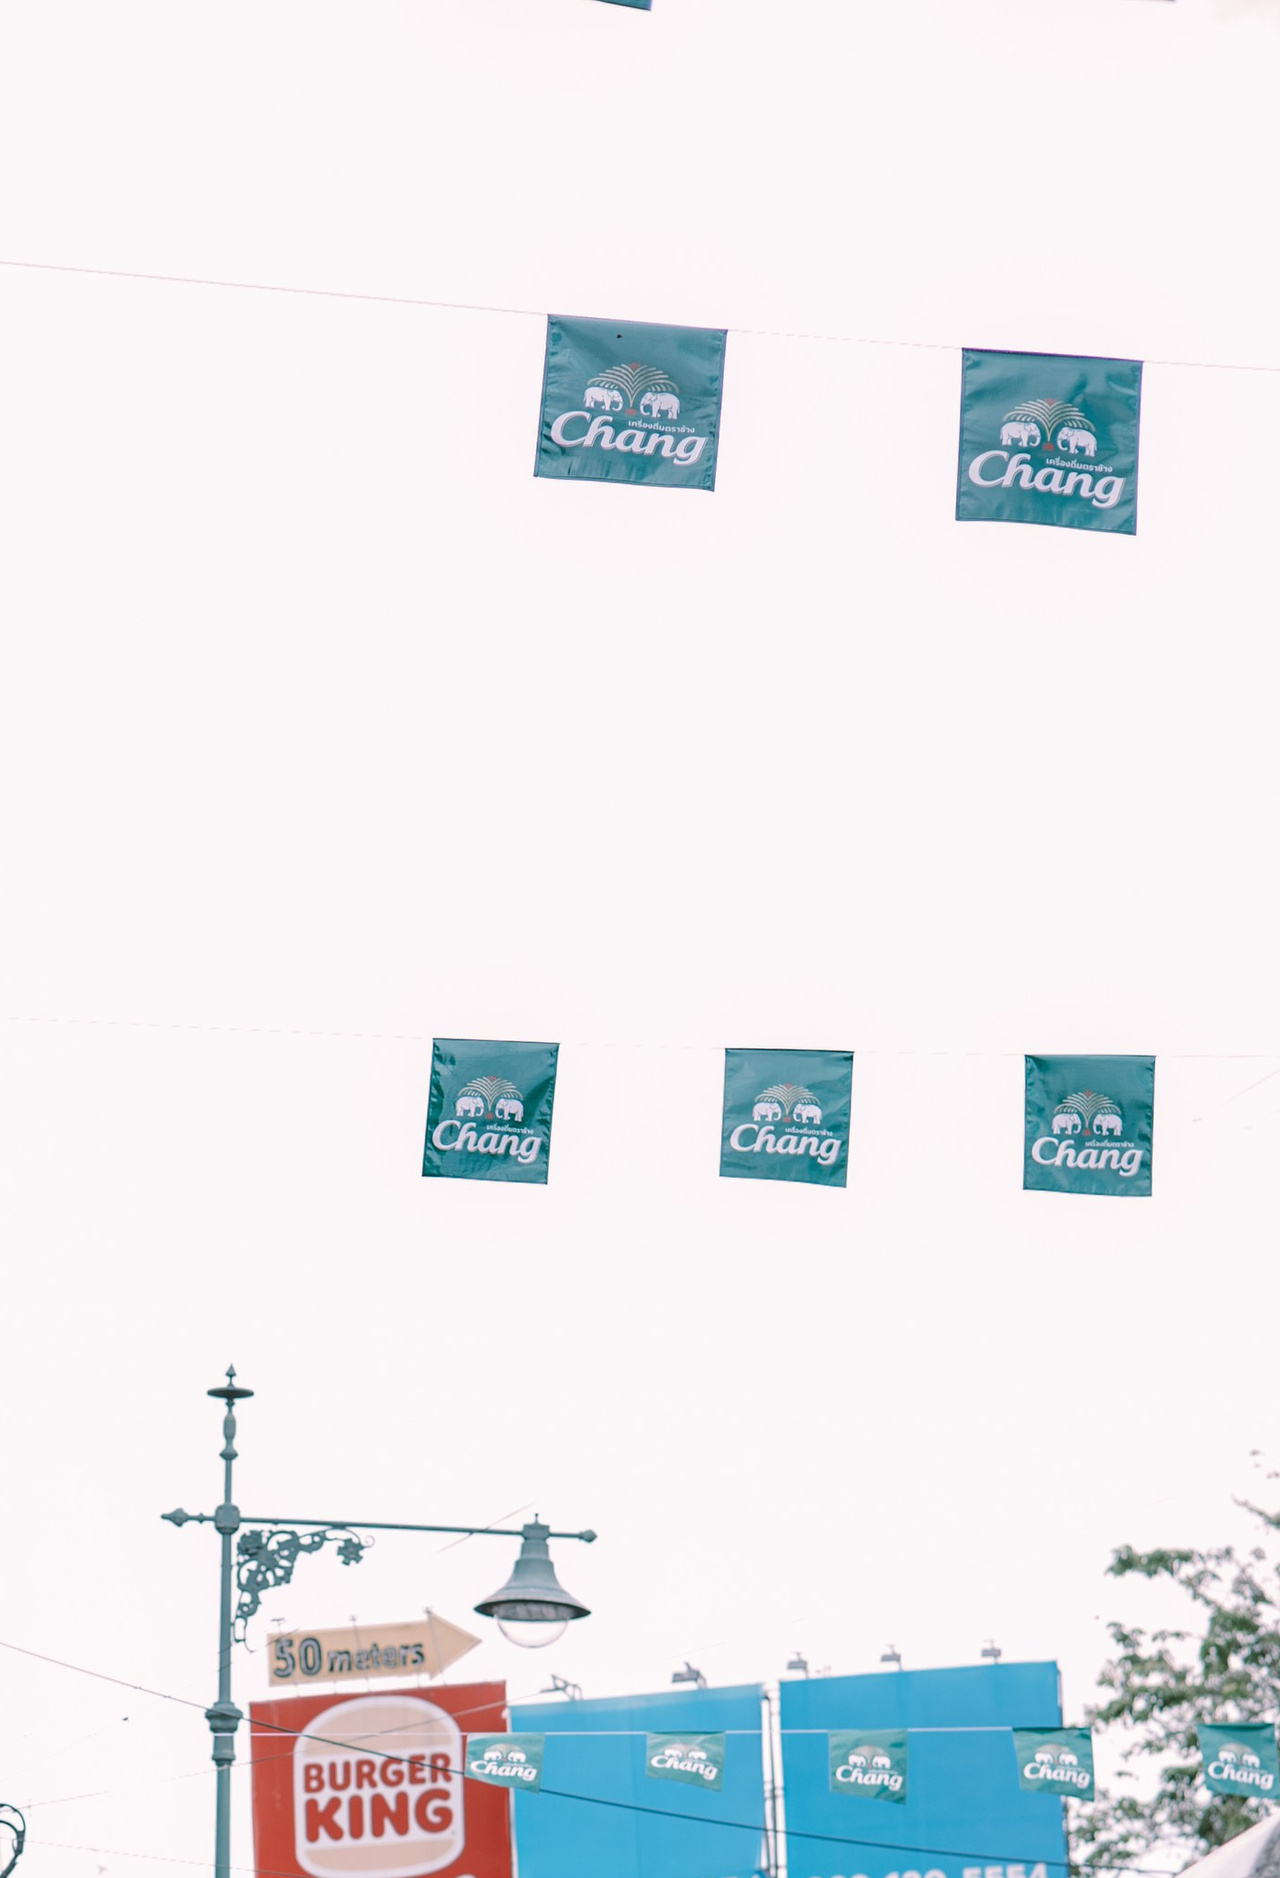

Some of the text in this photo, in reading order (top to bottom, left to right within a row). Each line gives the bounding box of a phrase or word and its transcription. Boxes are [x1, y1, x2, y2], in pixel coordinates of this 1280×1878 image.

[550, 410, 709, 466] Chang
[969, 450, 1127, 509] Chang
[432, 1119, 542, 1163] Chang
[730, 1123, 842, 1165] Chang
[1031, 1136, 1144, 1177] Chang
[273, 1636, 425, 1679] 50 meters
[303, 1752, 453, 1795] BURGER
[470, 1760, 538, 1782] Chang
[651, 1755, 717, 1781] Chang
[835, 1765, 903, 1791] Chang
[1023, 1762, 1091, 1789] Chang
[1207, 1761, 1274, 1791] Chang
[303, 1787, 454, 1844] KING
